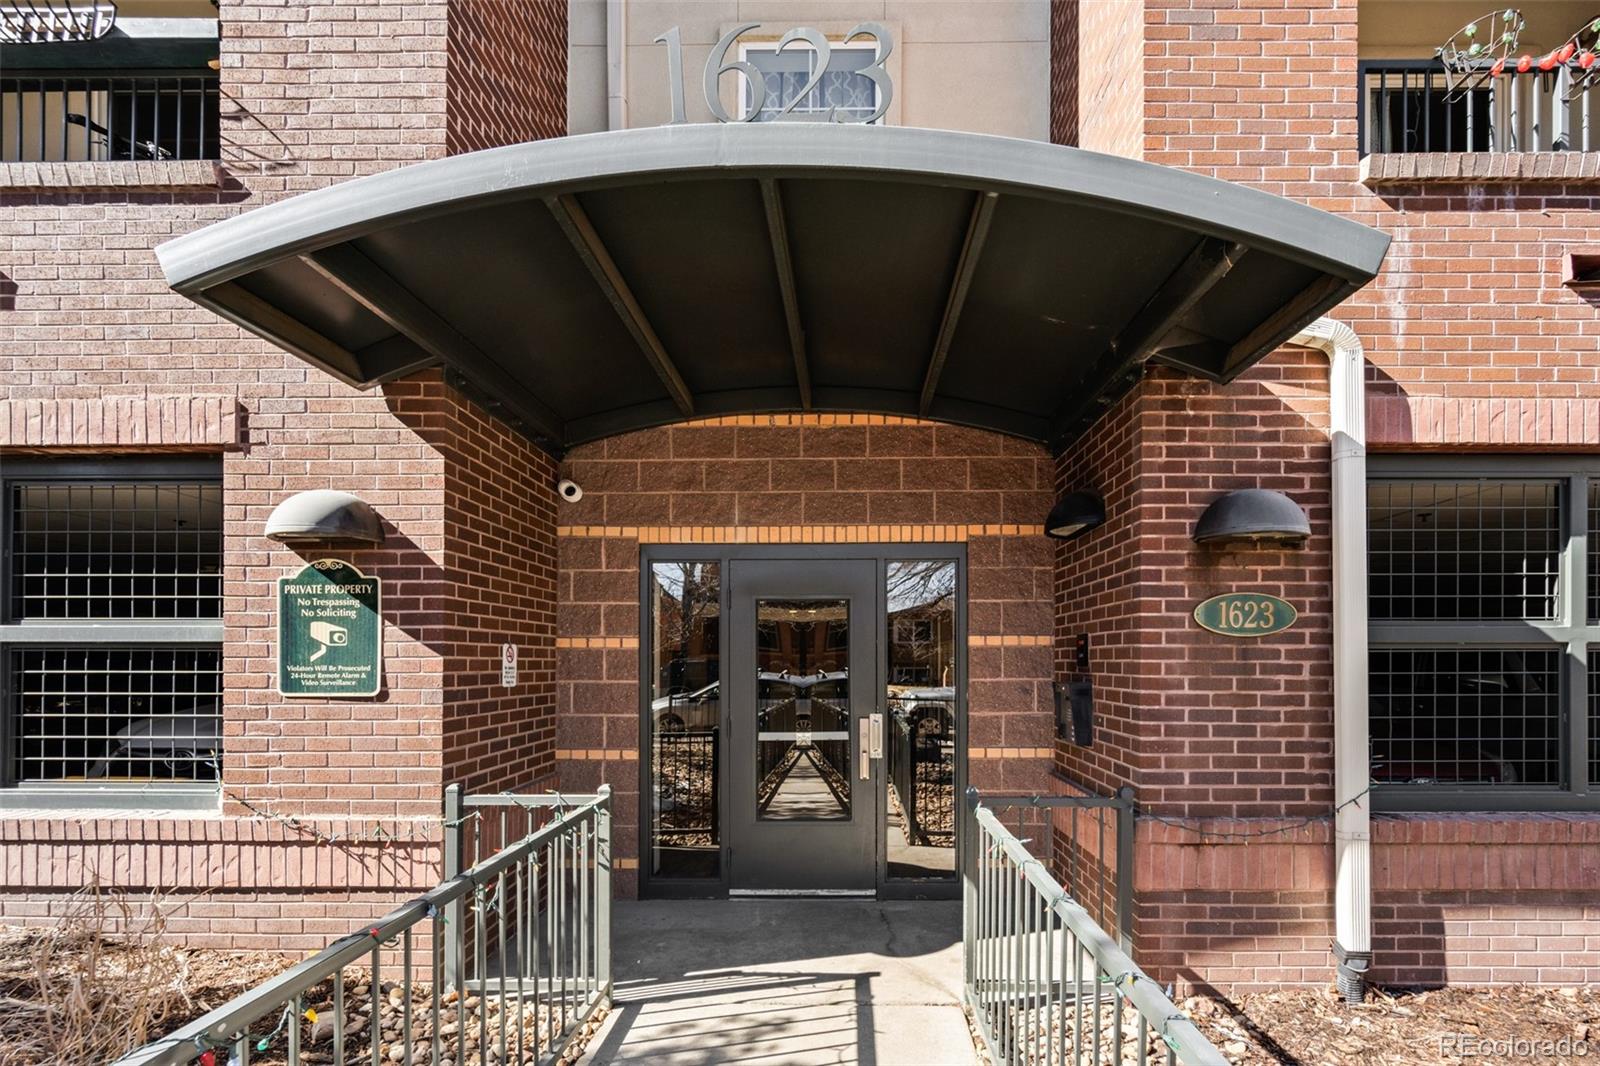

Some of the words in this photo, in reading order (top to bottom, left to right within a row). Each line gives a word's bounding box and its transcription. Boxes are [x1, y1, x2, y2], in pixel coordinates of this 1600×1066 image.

[653, 22, 895, 124] 1623
[284, 584, 323, 594] PRIVATE
[324, 584, 373, 594] PROPERTY
[297, 598, 311, 606] No
[312, 597, 361, 608] Trespassing
[301, 608, 315, 617] No
[316, 608, 357, 619] Soliciting
[1218, 601, 1275, 628] 1623
